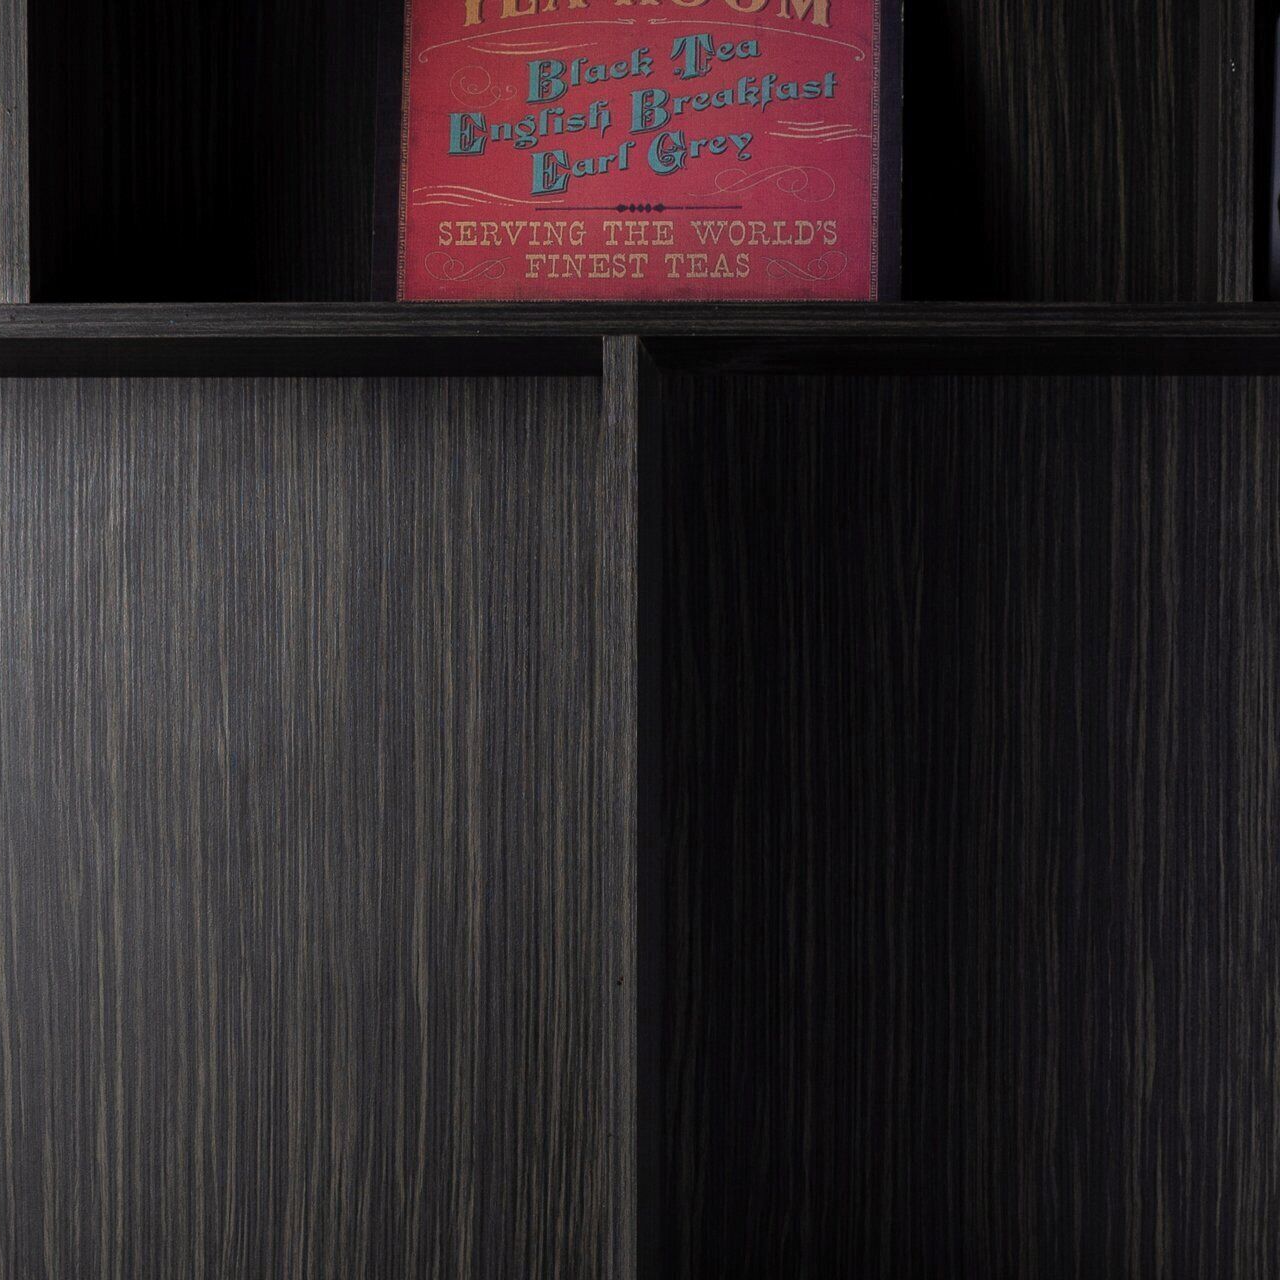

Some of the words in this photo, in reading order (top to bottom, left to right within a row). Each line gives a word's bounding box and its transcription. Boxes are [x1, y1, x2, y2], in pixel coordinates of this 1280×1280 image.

[525, 48, 654, 104] Black
[670, 32, 761, 80] Tea
[447, 101, 612, 157] English
[630, 71, 840, 134] Breakfast
[530, 142, 635, 196] Earl
[647, 129, 755, 176] Grey
[438, 220, 587, 247] SERVING
[603, 220, 675, 246] THE
[691, 220, 839, 246] WORLD'S
[525, 254, 650, 280] FINEST
[665, 253, 752, 280] TEAS
